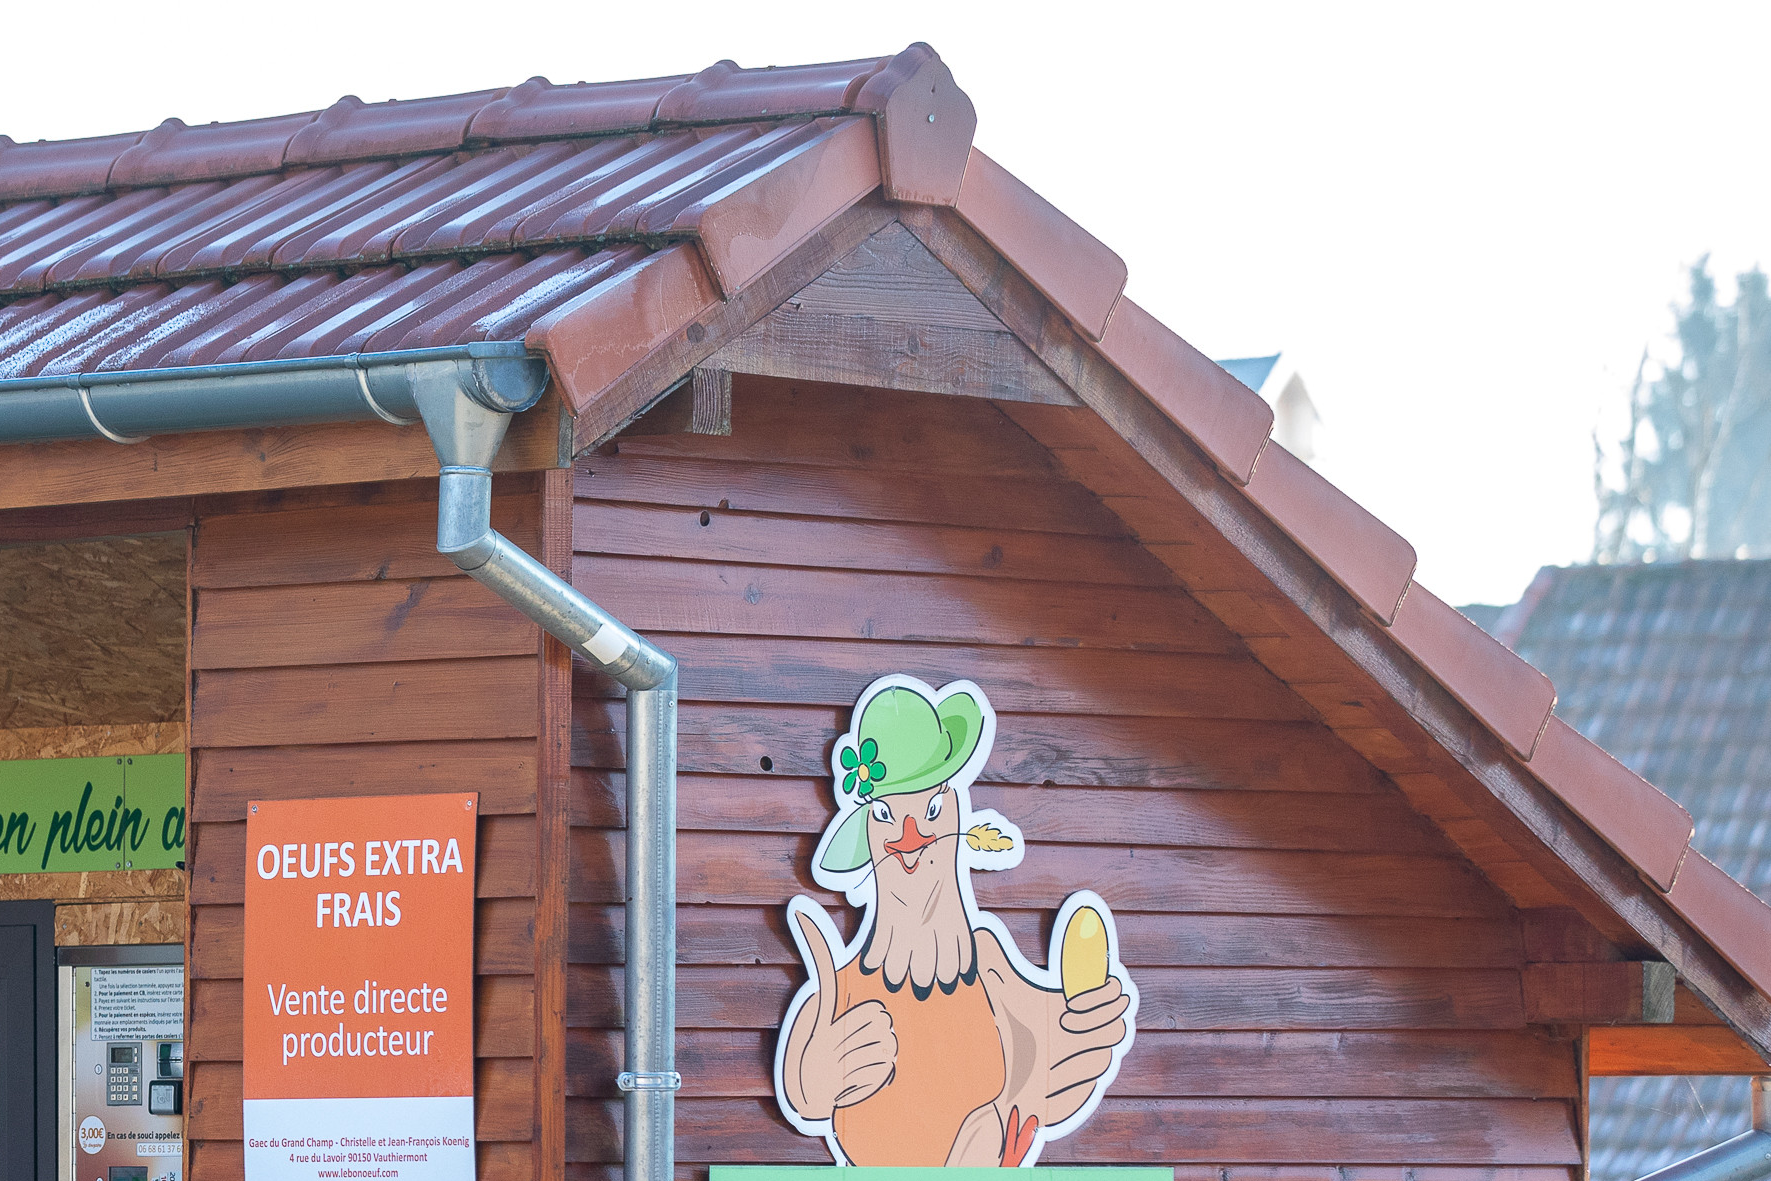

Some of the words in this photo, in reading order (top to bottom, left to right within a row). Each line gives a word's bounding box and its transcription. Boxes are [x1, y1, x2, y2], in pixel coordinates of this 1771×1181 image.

[42, 781, 150, 869] plein
[257, 841, 356, 880] OEUFS
[365, 838, 464, 876] EXTRA
[316, 890, 402, 928] FRAIS
[267, 984, 345, 1016] Vente
[353, 979, 448, 1014] directe
[282, 1022, 434, 1066] producteur
[81, 1127, 104, 1140] 3,00€
[128, 1131, 136, 1139] de
[138, 1131, 154, 1139] souci
[155, 1131, 180, 1141] appelez
[139, 1144, 146, 1153] 06
[148, 1144, 156, 1153] 68
[158, 1144, 165, 1153] 61
[167, 1144, 175, 1153] 37
[249, 1138, 268, 1148] Gaec
[270, 1138, 279, 1147] du
[281, 1138, 305, 1147] Grand
[306, 1137, 333, 1149] Champ
[340, 1137, 376, 1147] Christelle
[378, 1138, 386, 1146] et
[388, 1137, 440, 1148] Jean-François
[442, 1136, 469, 1148] Koenig
[289, 1153, 294, 1162] 4
[296, 1155, 309, 1163] rue
[311, 1153, 321, 1162] du
[323, 1152, 346, 1162] Lavoir
[348, 1152, 371, 1162] 90150
[373, 1152, 427, 1162] Vauthiermont
[170, 1172, 176, 1181] 20
[318, 1167, 399, 1178] www.lebonoeuf.com
